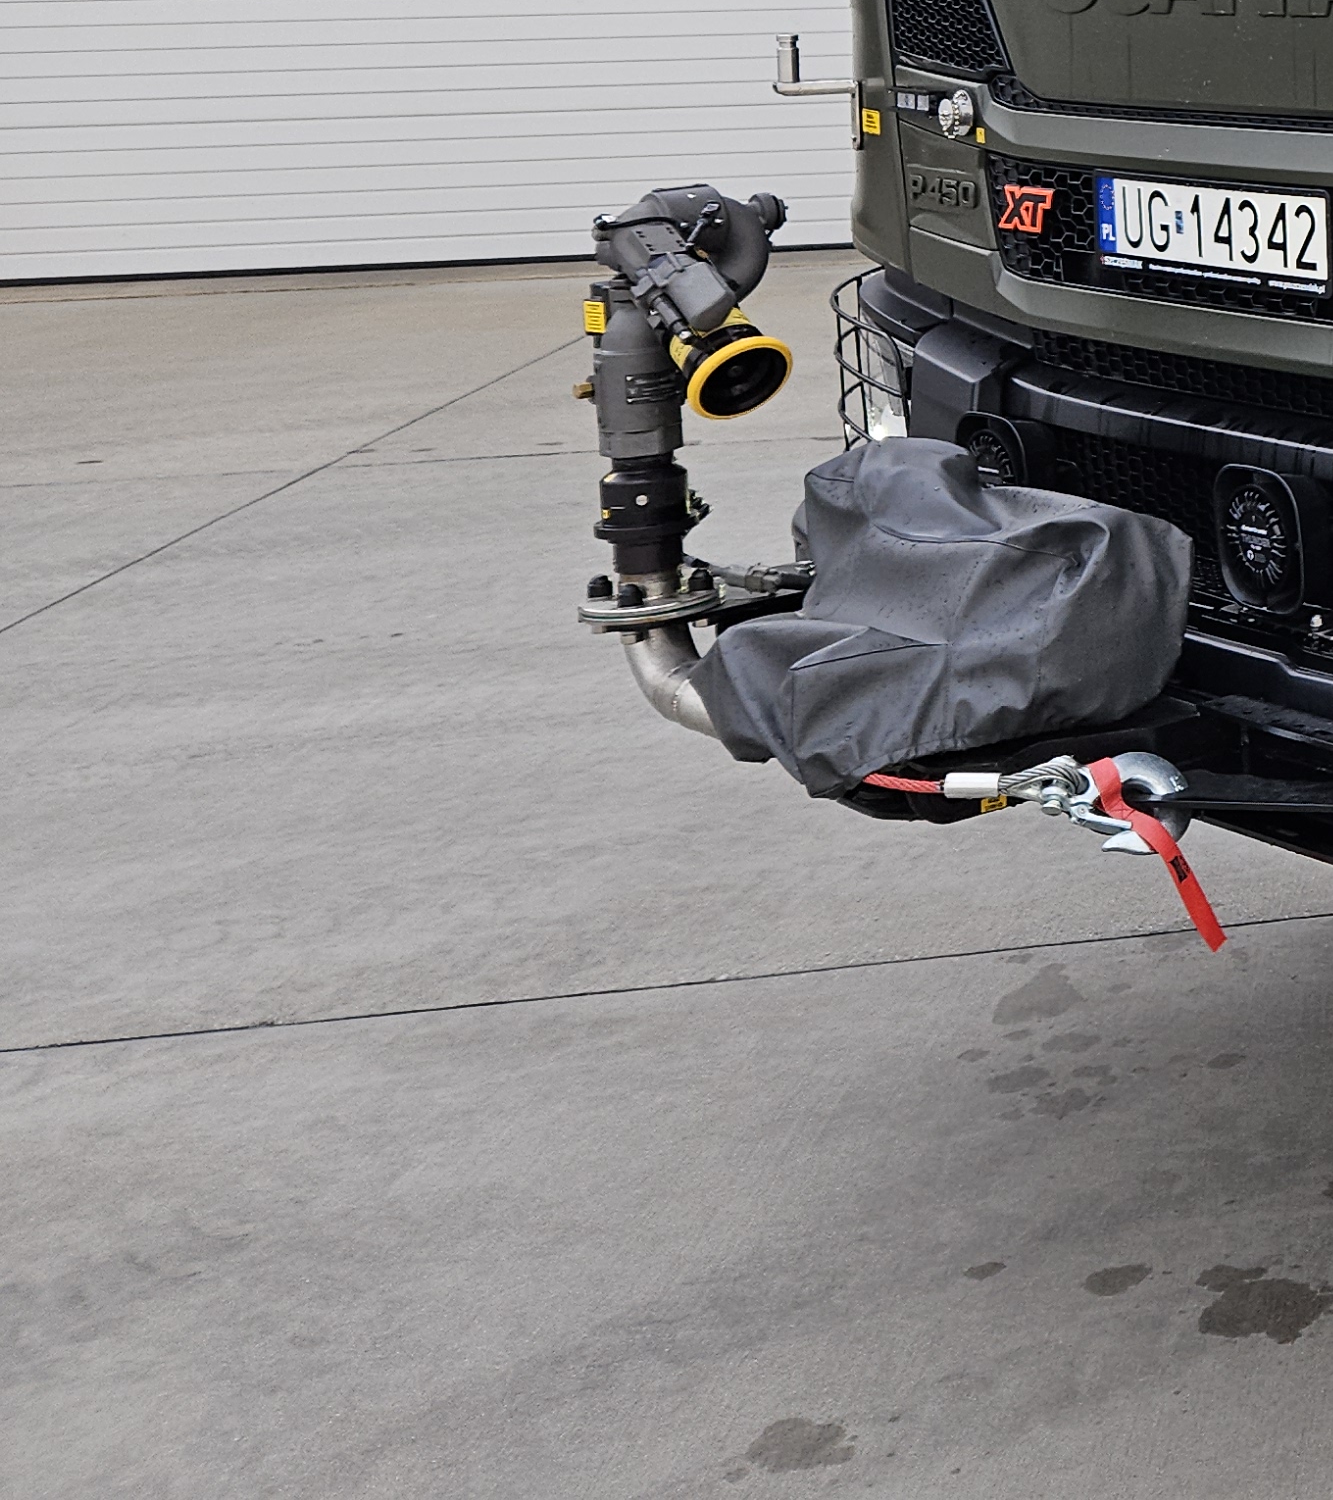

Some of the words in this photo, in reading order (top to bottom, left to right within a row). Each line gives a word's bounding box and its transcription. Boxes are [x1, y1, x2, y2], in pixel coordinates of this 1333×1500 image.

[999, 183, 1055, 234] XT
[1102, 223, 1116, 242] PL
[1190, 193, 1318, 271] 14342
